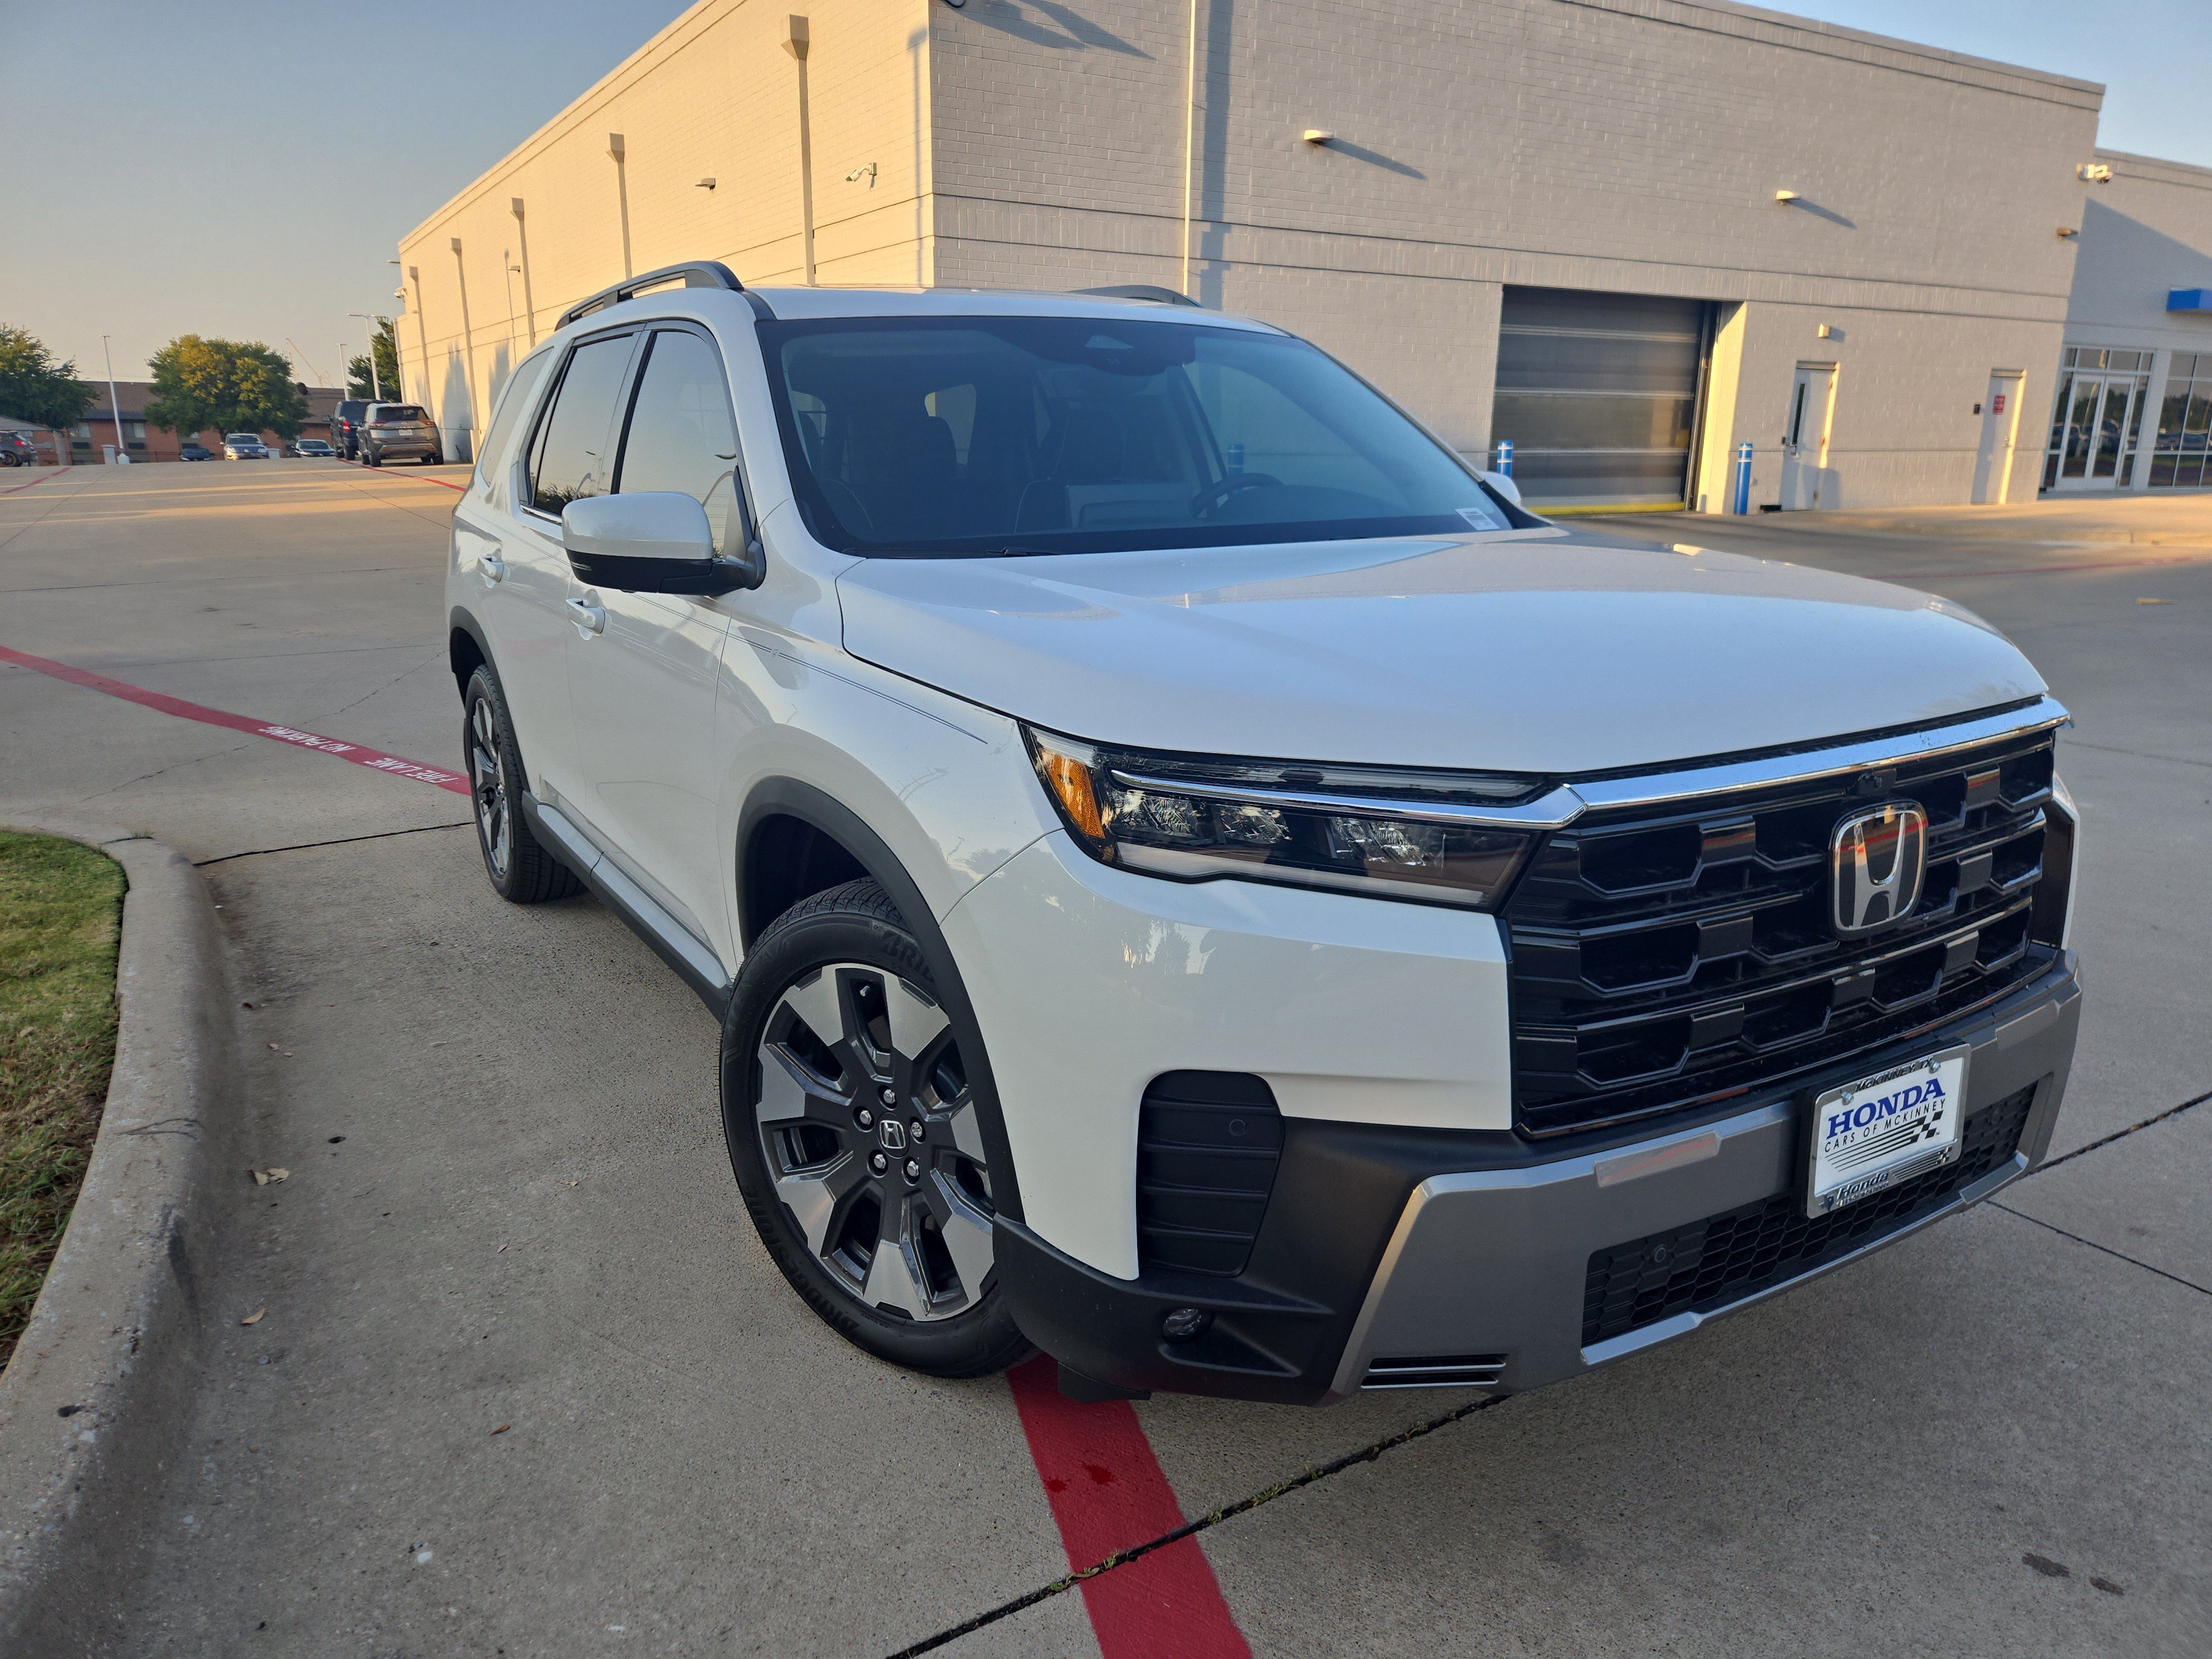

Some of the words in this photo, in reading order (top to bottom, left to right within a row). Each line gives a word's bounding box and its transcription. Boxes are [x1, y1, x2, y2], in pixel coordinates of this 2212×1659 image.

[258, 726, 332, 746] PARKING
[318, 743, 356, 753] NO
[363, 757, 423, 773] LANE
[406, 770, 459, 783] FIRE
[1826, 1078, 1946, 1140] HONDA
[1824, 1133, 1855, 1153] CARS
[1863, 1124, 1877, 1137] OF
[1884, 1099, 1945, 1130] MCKINNEY
[1836, 1172, 1889, 1200] Honda
